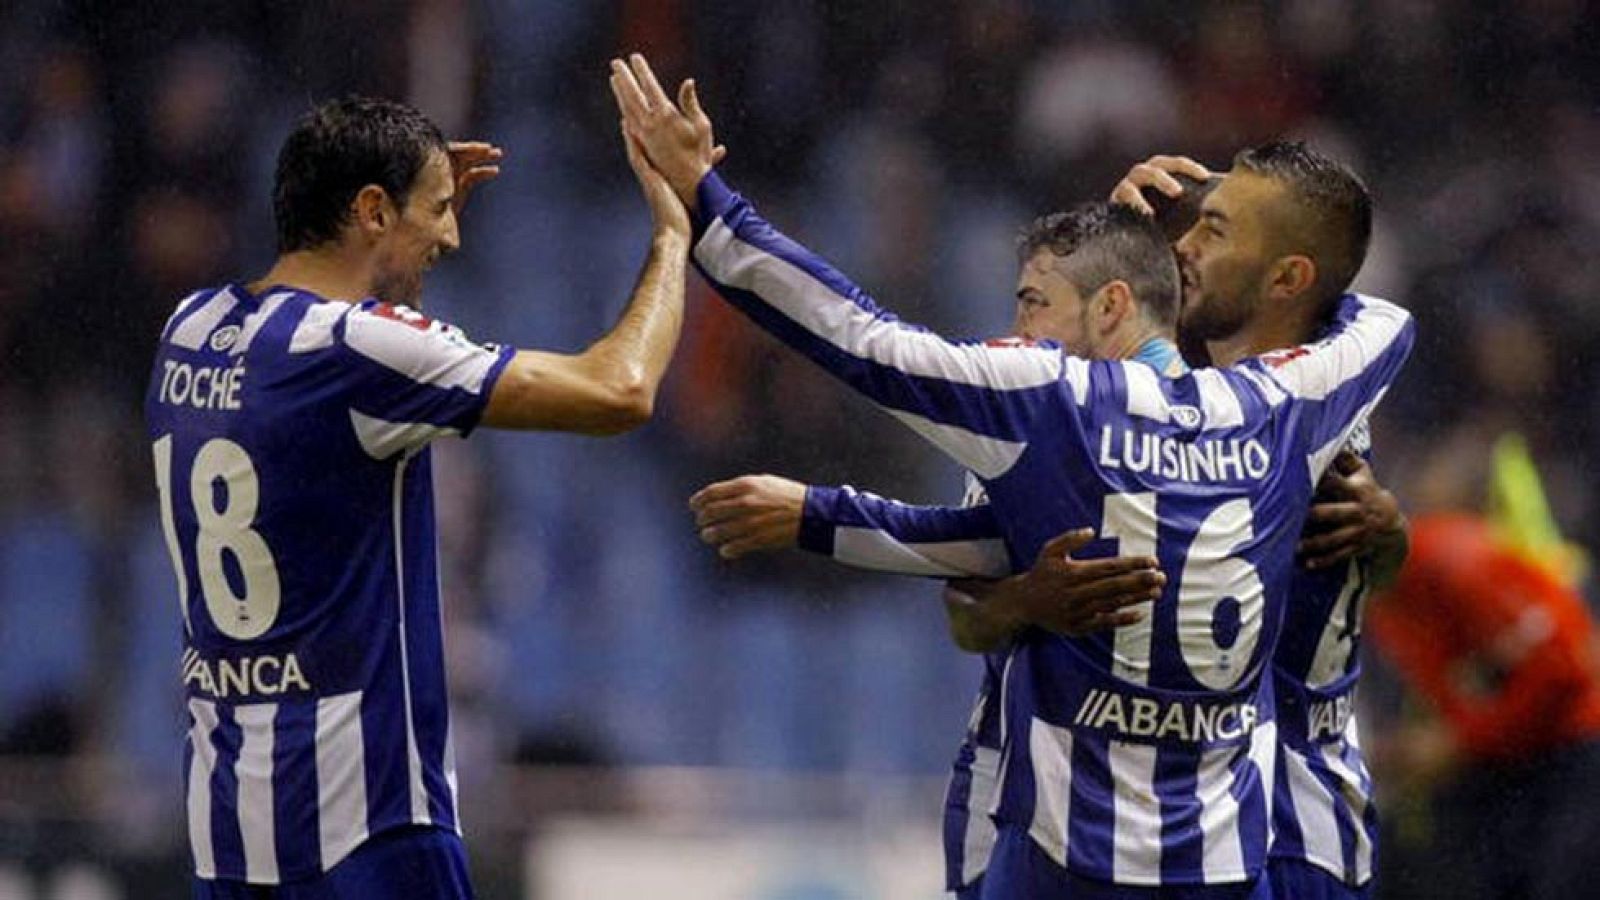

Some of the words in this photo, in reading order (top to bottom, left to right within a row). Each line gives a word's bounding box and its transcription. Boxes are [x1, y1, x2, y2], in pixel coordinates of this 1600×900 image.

[159, 355, 246, 411] TOCHÉ
[1100, 425, 1270, 482] LUISINHO
[152, 433, 282, 641] 18
[1101, 492, 1265, 690] 16
